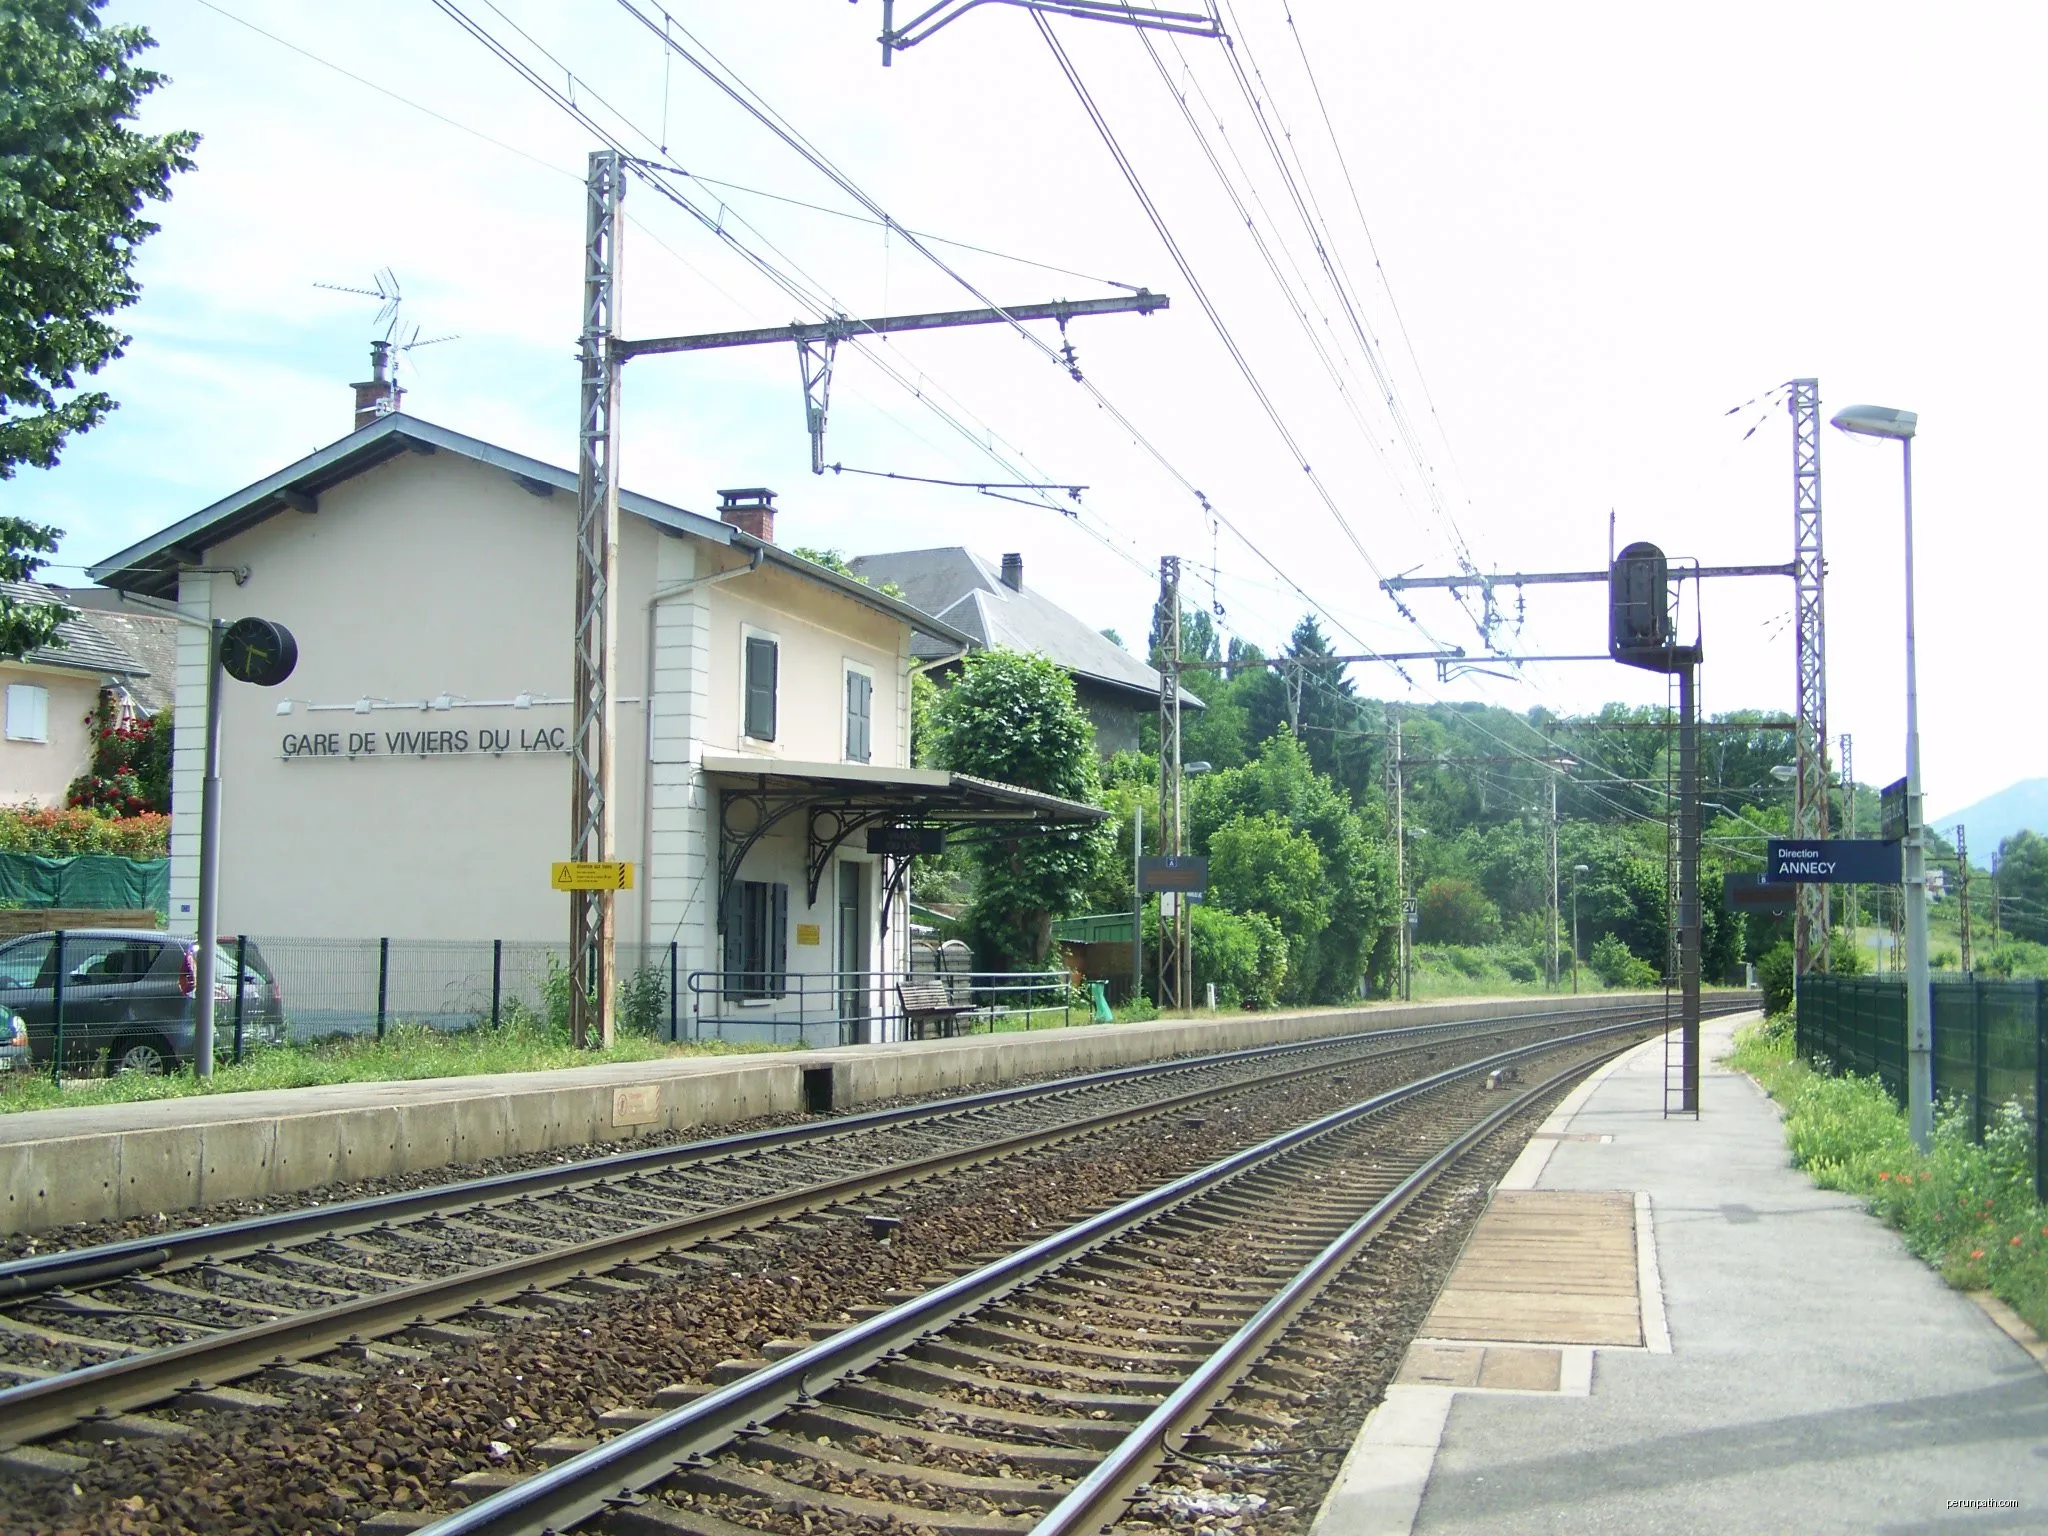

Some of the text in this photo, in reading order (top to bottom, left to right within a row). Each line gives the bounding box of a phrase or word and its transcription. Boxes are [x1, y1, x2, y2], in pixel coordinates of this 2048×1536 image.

[282, 727, 565, 755] GARE DE VIVIERS DU LAC
[1778, 848, 1819, 859] Direction
[1778, 862, 1836, 875] ANNECY
